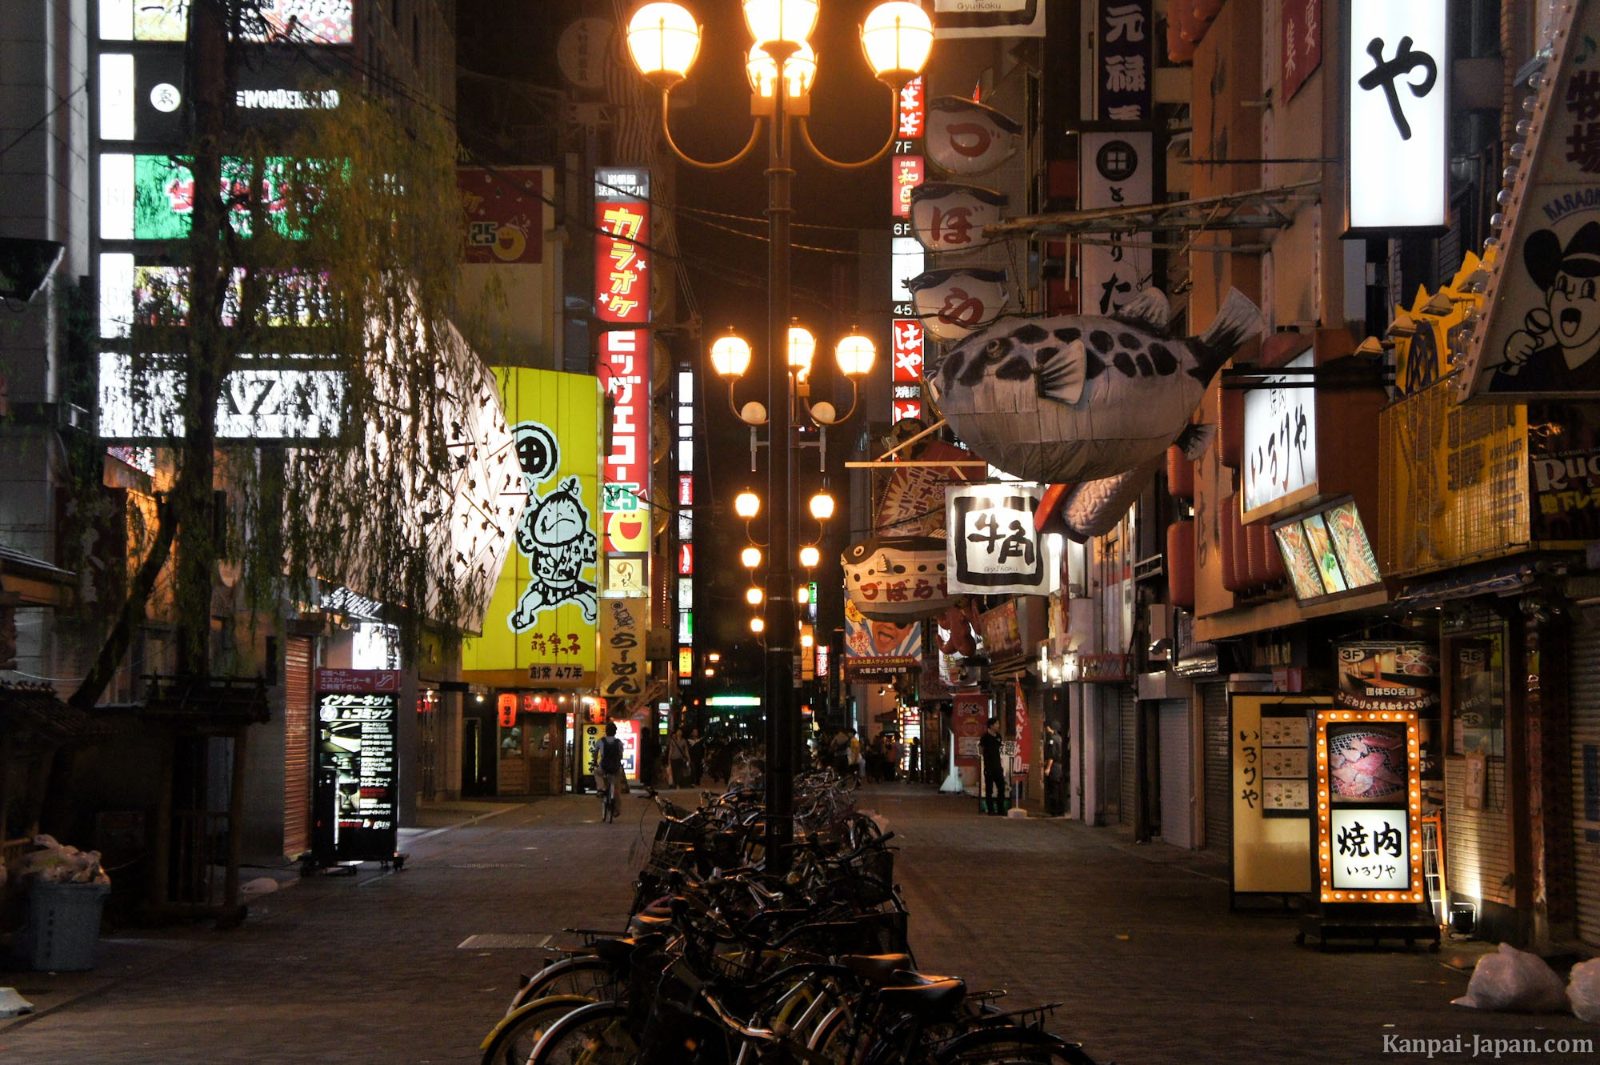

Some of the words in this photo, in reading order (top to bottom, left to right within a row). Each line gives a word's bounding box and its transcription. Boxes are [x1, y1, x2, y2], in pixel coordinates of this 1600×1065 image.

[1358, 35, 1438, 141] や
[895, 142, 912, 153] 7F
[470, 223, 496, 245] 25
[893, 223, 911, 236] 6F
[603, 207, 643, 318] カラオケ
[895, 323, 922, 378] はや
[608, 331, 641, 481] ビッグエコー
[895, 385, 921, 398] 焼肉
[1250, 403, 1308, 493] いろりや
[967, 512, 1036, 566] 牛角
[606, 632, 641, 695] らーめん
[1342, 650, 1360, 660] 3F
[529, 666, 552, 679] 創業
[555, 666, 582, 679] 47年
[321, 694, 392, 706] インターネット
[341, 708, 392, 719] &コミック
[1240, 730, 1259, 809] いろりや
[1337, 821, 1402, 858] 焼肉
[1347, 864, 1397, 880] いろりや
